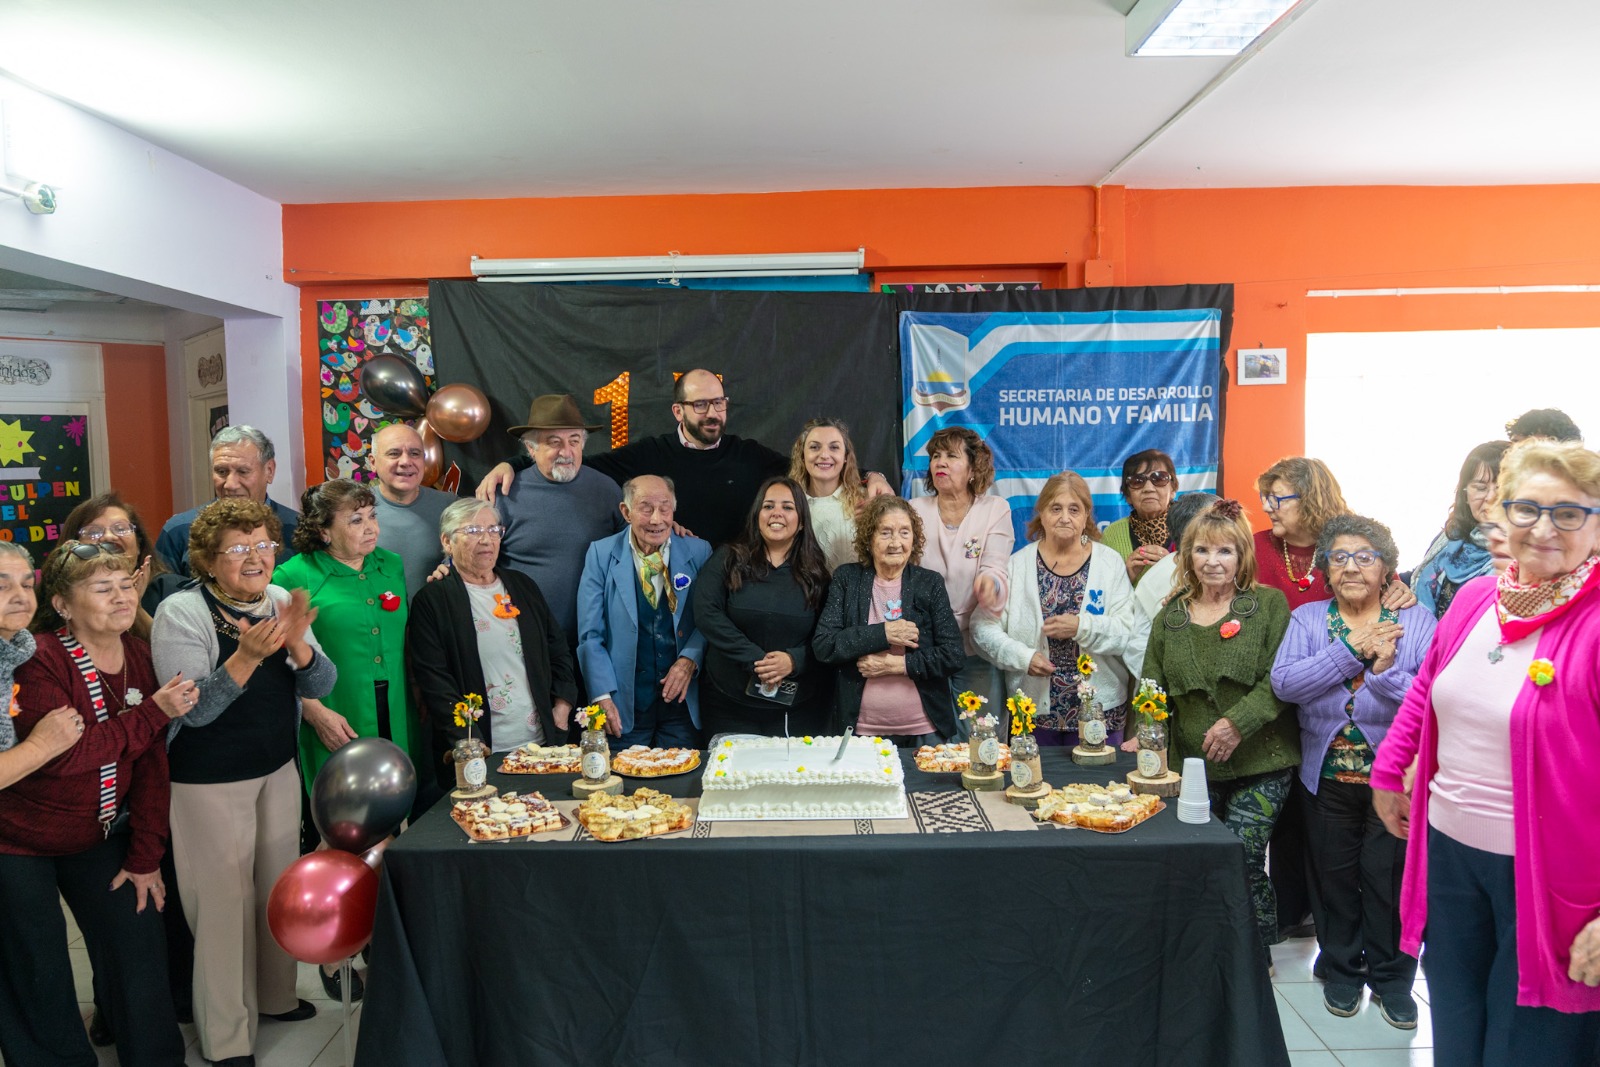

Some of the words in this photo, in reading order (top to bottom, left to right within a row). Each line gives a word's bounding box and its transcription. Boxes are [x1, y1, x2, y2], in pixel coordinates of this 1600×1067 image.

[999, 388, 1093, 403] SECRETARIA
[1096, 388, 1115, 401] DE
[1118, 385, 1213, 401] DESARROLLO
[1000, 405, 1102, 426] HUMANO
[1106, 405, 1121, 425] Y
[1126, 402, 1214, 425] FAMILIA
[1, 504, 29, 521] EL
[0, 523, 66, 543] ORDE
